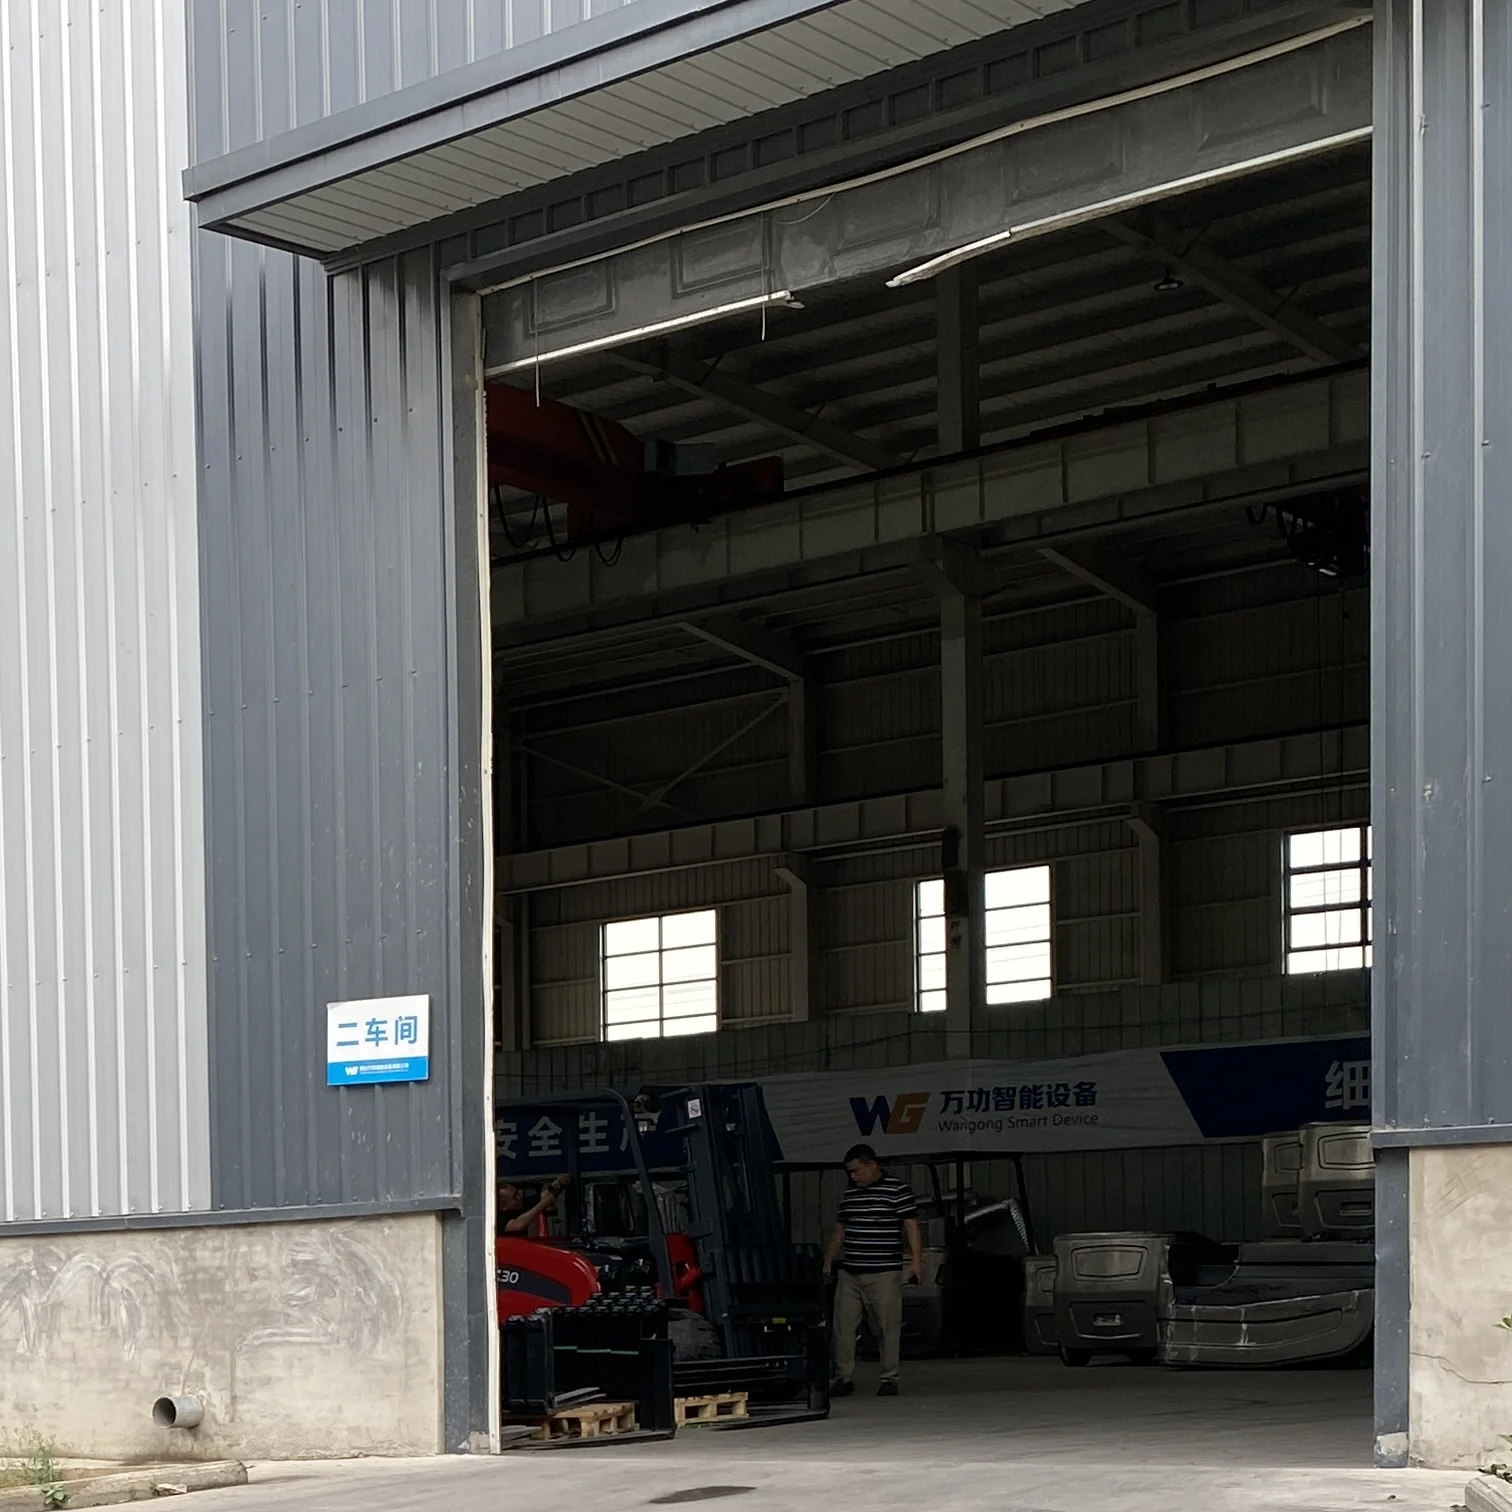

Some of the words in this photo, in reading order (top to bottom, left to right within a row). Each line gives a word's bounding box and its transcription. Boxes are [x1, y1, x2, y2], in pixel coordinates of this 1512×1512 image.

[336, 1015, 418, 1048] 二车间
[939, 1081, 1098, 1114] 万功智能设备
[1325, 1060, 1370, 1109] 细
[849, 1092, 931, 1136] WG
[937, 1115, 1004, 1134] Wangong
[1007, 1114, 1047, 1129] Smart
[1052, 1112, 1099, 1127] Device
